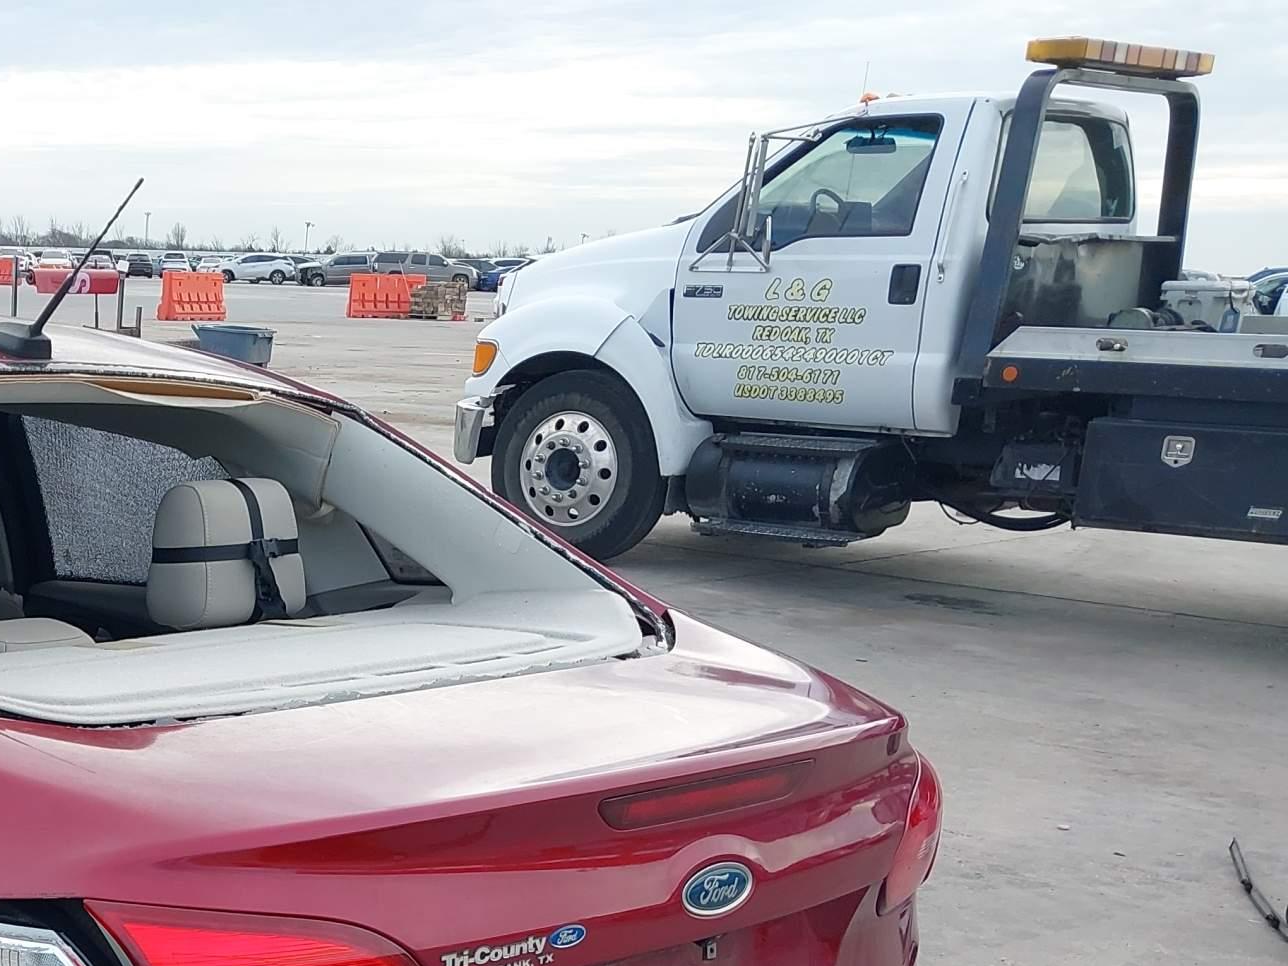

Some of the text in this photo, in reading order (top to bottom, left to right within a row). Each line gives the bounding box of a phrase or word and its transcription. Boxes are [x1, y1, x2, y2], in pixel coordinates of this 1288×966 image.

[765, 277, 833, 302] L & G
[727, 305, 866, 324] TOWING SERVICE LLC
[752, 325, 835, 344] RED OAK, TX
[737, 365, 841, 385] 817-504-6171
[734, 384, 845, 404] USDOT 3388495
[700, 872, 739, 905] Ford
[556, 929, 579, 945] Ford
[538, 953, 555, 966] TX
